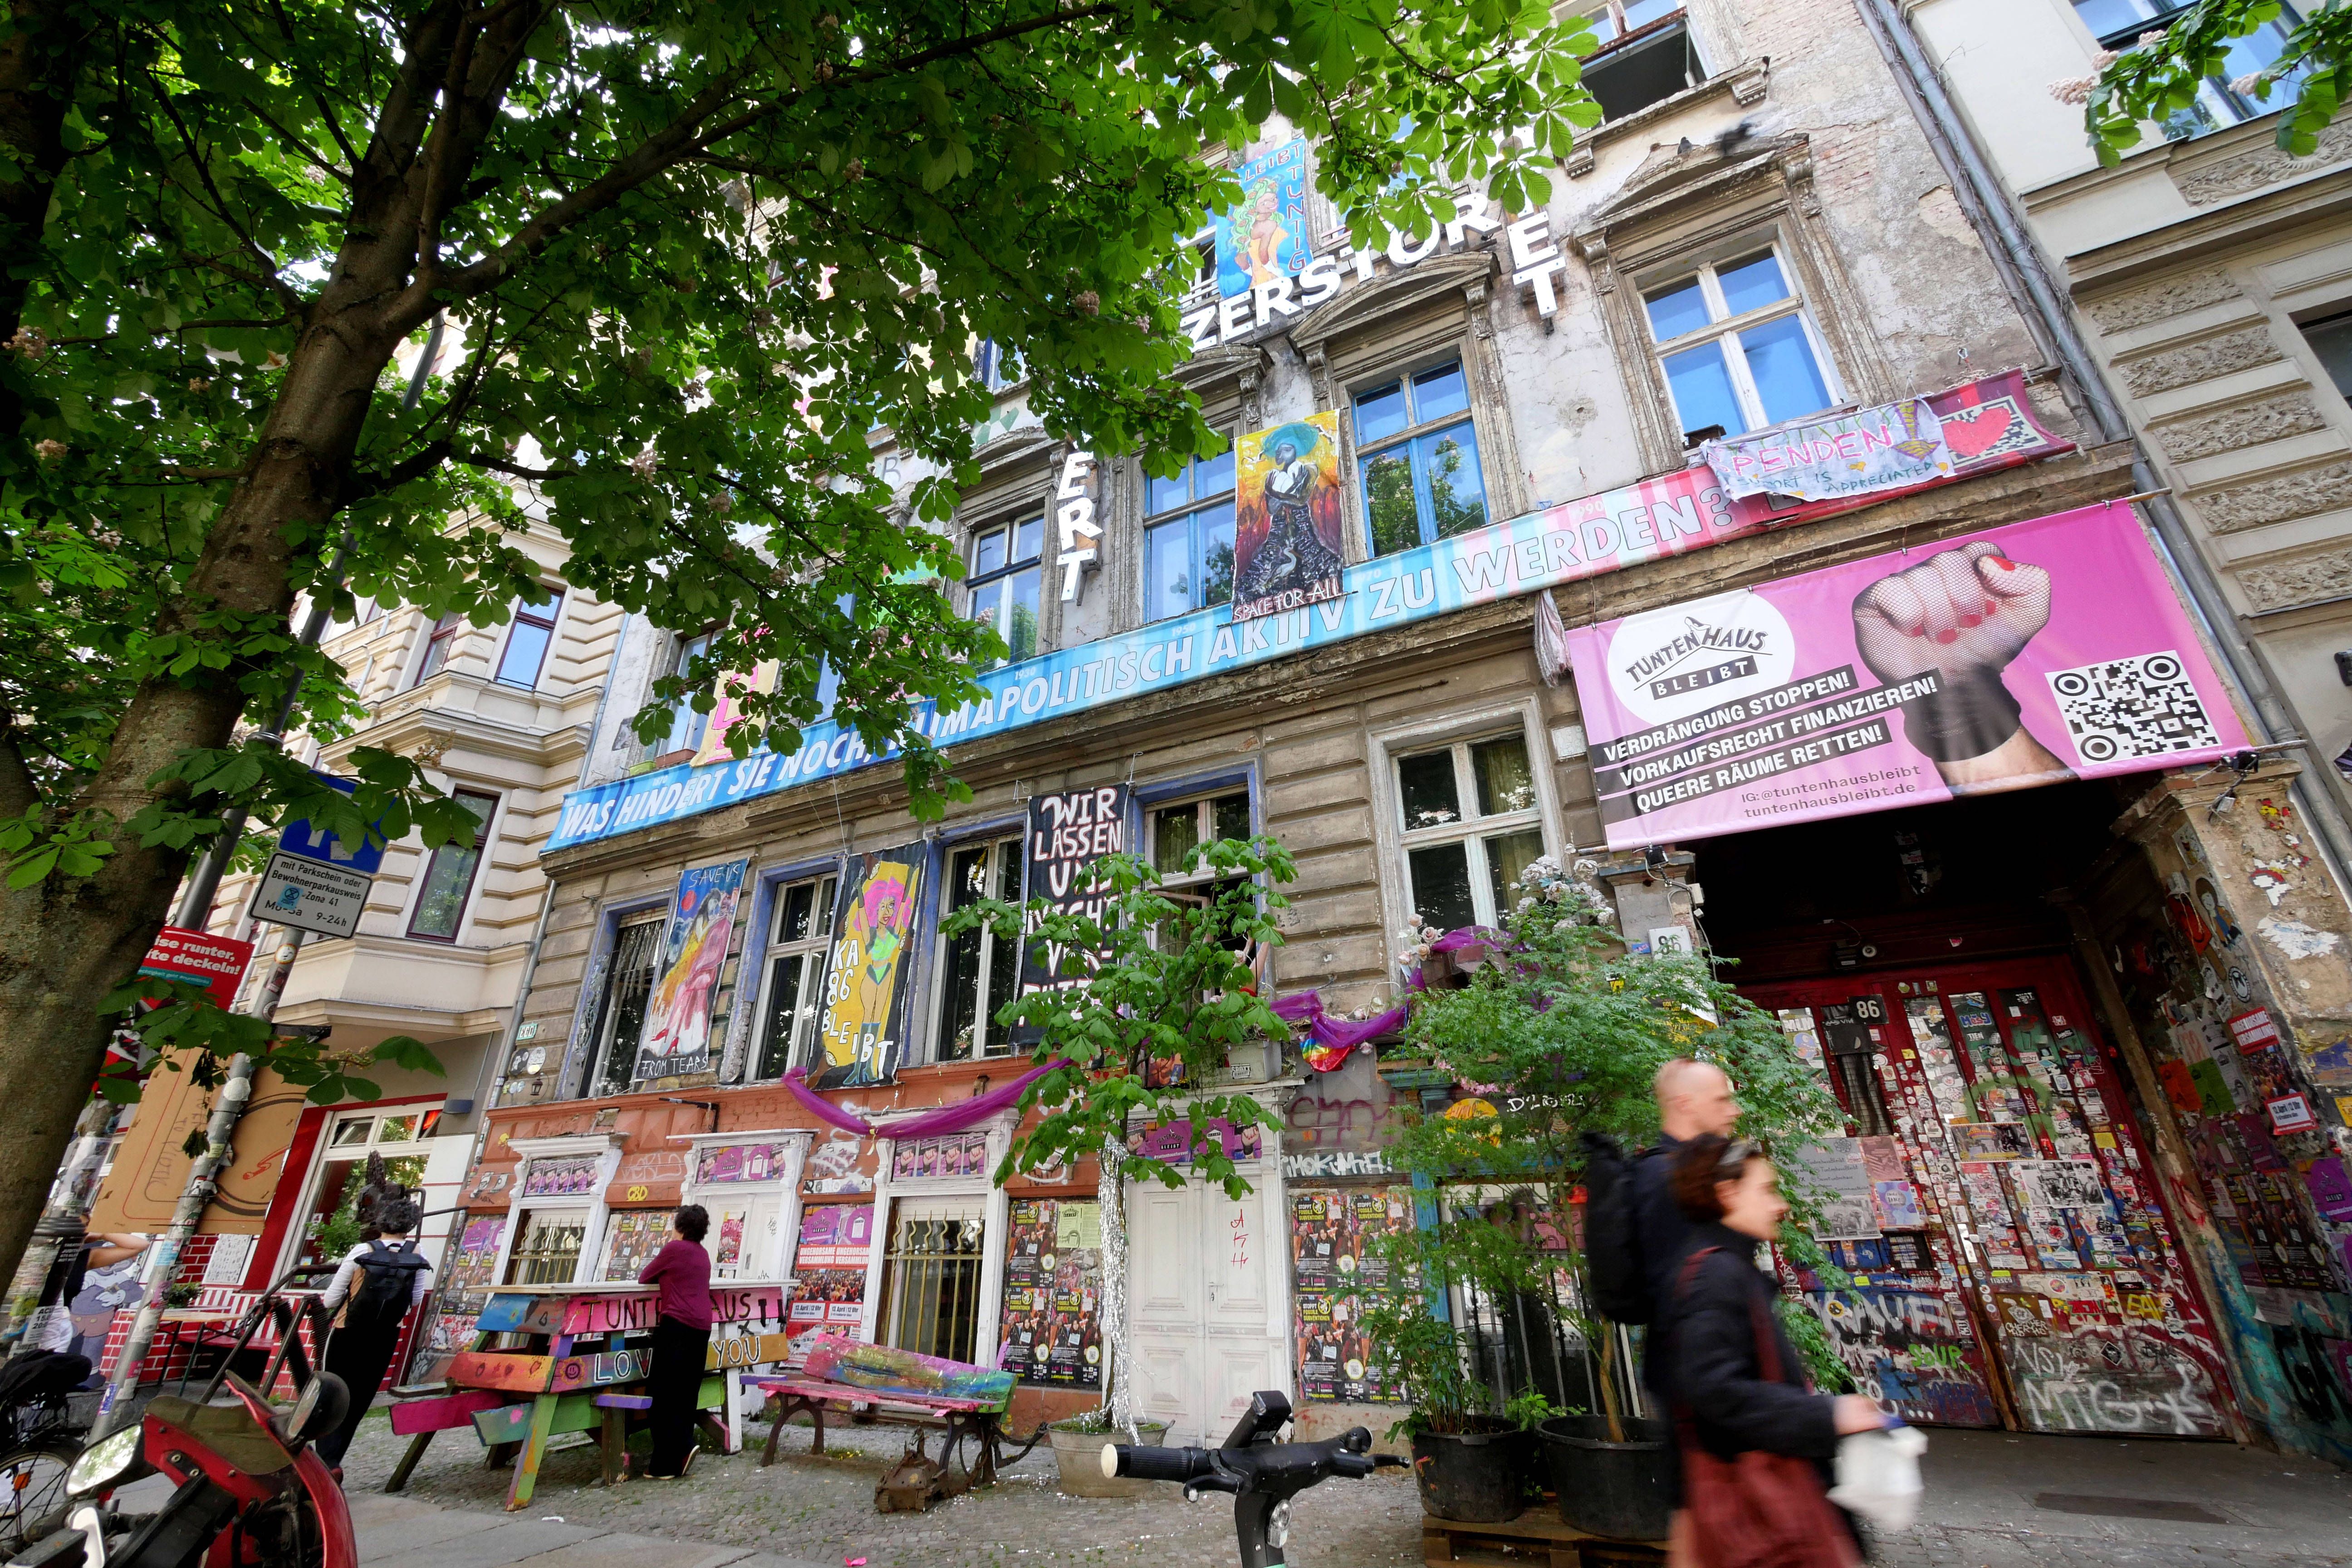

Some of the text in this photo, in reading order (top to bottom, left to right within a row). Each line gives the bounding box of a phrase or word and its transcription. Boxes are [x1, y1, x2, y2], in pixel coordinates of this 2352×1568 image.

[1229, 142, 1301, 184] LEIBT
[1825, 462, 1933, 493] APPRECIATED
[1233, 576, 1341, 622] SPACE FOR ALL
[1171, 622, 1196, 636] 1950
[558, 796, 616, 840] WAS
[614, 767, 729, 827] HINDERT
[727, 755, 777, 796] SIE
[1208, 595, 1347, 665] AKTIV
[1368, 567, 1436, 621] ZU
[1450, 485, 1734, 593] WERDEN?
[1014, 666, 1036, 681] 1930
[1656, 660, 1749, 696] BLEIBT
[1604, 671, 1851, 762] VERDRÄNGUNG STOPPEN!
[1620, 676, 1938, 788] VORKAUFSRECHT FINANZIEREN!
[1637, 724, 1883, 812] QUEERE RÄUME RETTEN!
[1041, 788, 1117, 829] WIR
[1744, 783, 1916, 818] tuntenhausbleibt.de
[1034, 819, 1123, 862] LASSEN
[271, 870, 362, 901] Bewohnerparkausweis
[281, 861, 363, 888] mit Parkschein oder
[688, 863, 741, 888] SAVE US
[328, 898, 339, 907] 41
[172, 953, 241, 975] deckeln!
[182, 943, 235, 962] runter,
[831, 939, 859, 971] KA
[827, 968, 852, 1007] 86
[1856, 1000, 1880, 1019] 86
[822, 1009, 894, 1080] BLEIBT
[642, 1055, 708, 1078] FROM TEARS
[722, 1220, 744, 1233] RAVE
[799, 1256, 834, 1264] VERSAMMLUNG
[800, 1247, 836, 1255] UNGEHORSAME
[594, 1335, 760, 1383] LOV YOU
[1908, 1343, 1971, 1373] SOUP
